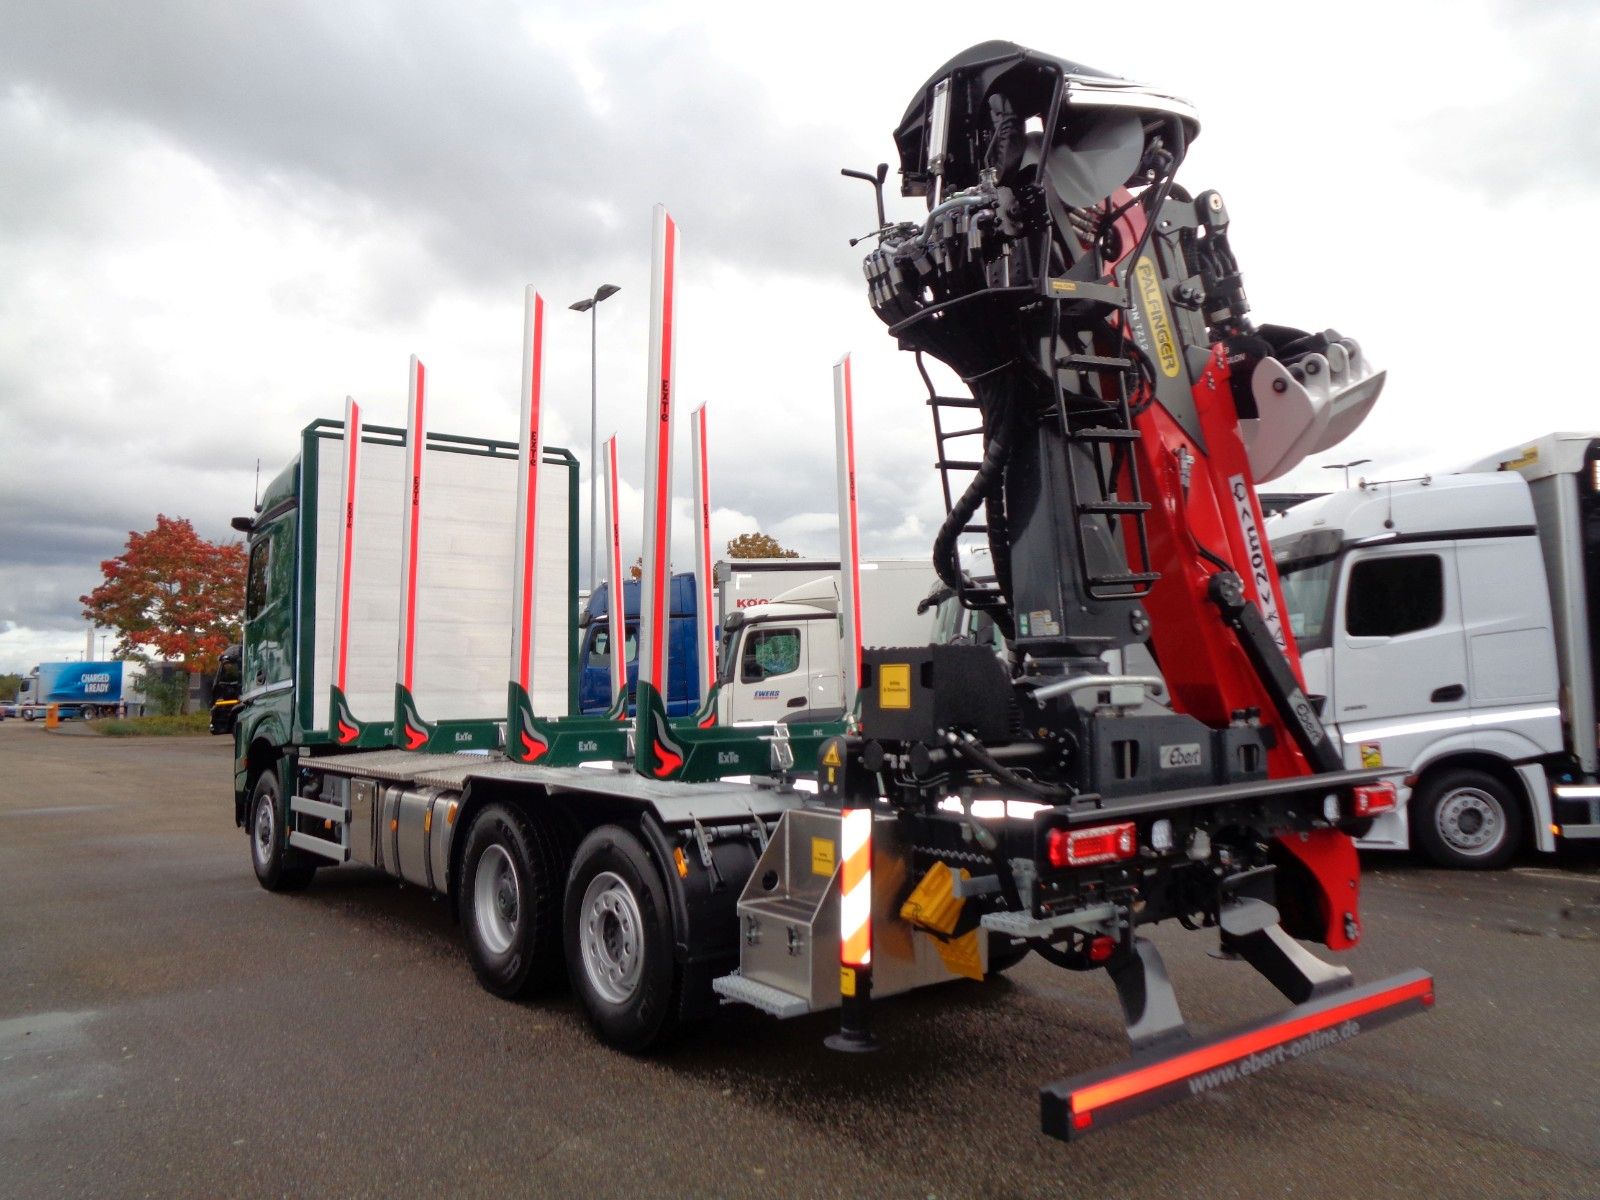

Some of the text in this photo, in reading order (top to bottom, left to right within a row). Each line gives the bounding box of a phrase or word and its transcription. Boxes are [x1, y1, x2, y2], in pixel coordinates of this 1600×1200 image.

[1137, 262, 1176, 370] PALFINGER
[81, 673, 110, 683] CHARGED
[578, 741, 598, 751] ExTe
[718, 751, 740, 764] ExTe
[1188, 1019, 1361, 1095] www.ebert-online.de
